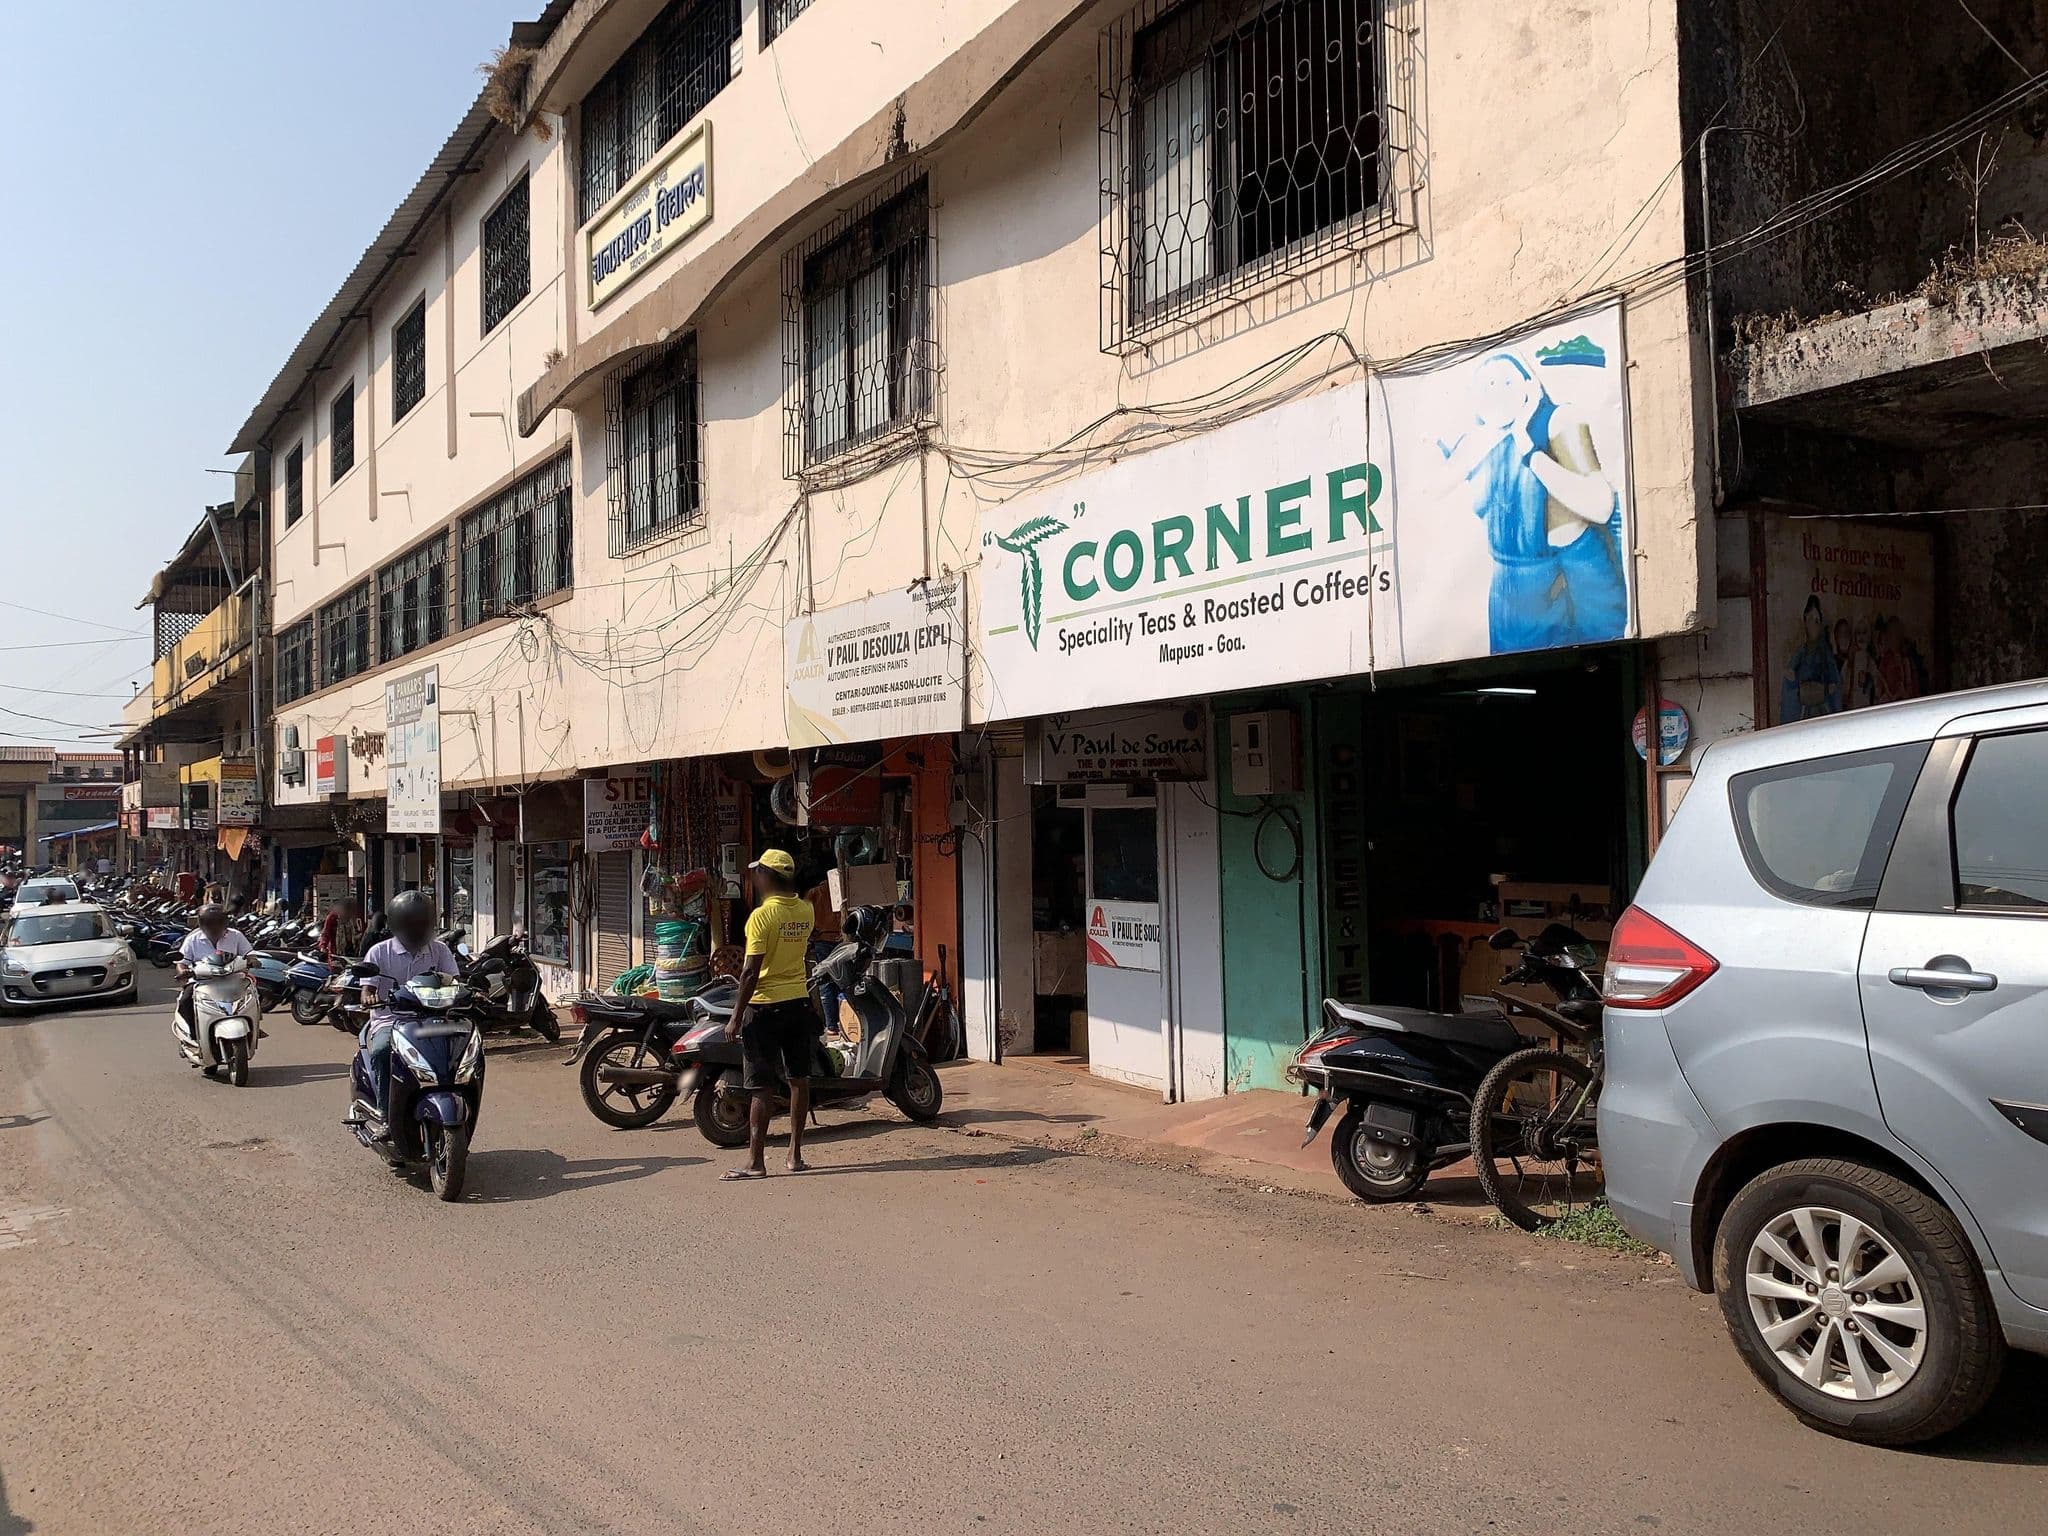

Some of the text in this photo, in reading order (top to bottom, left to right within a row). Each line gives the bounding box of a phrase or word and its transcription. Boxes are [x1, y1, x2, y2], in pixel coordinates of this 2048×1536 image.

[1062, 462, 1385, 602] CORNER
[1811, 568, 1828, 593] de
[1058, 618, 1134, 657] Speciality
[1138, 611, 1176, 637] Teas
[1183, 602, 1197, 628] &
[1204, 581, 1284, 624] Roasted
[827, 622, 891, 645] AUTHORIZED DISTRIBUTOR
[827, 622, 952, 668] V PAUL DESOUZA (EXPL)
[1159, 641, 1204, 665] Mapusa
[1217, 632, 1246, 654] Goa.
[794, 664, 824, 682] AXALTA
[827, 658, 909, 683] AUTOMOTIVE REFINISH PAINTS
[1047, 731, 1203, 757] V. Paul de Souza
[1077, 758, 1093, 769] THE
[588, 818, 603, 826] ALSO
[604, 817, 630, 826] DEALING
[1117, 922, 1133, 941] PAUL
[1135, 923, 1143, 941] DE
[1340, 915, 1356, 938] &
